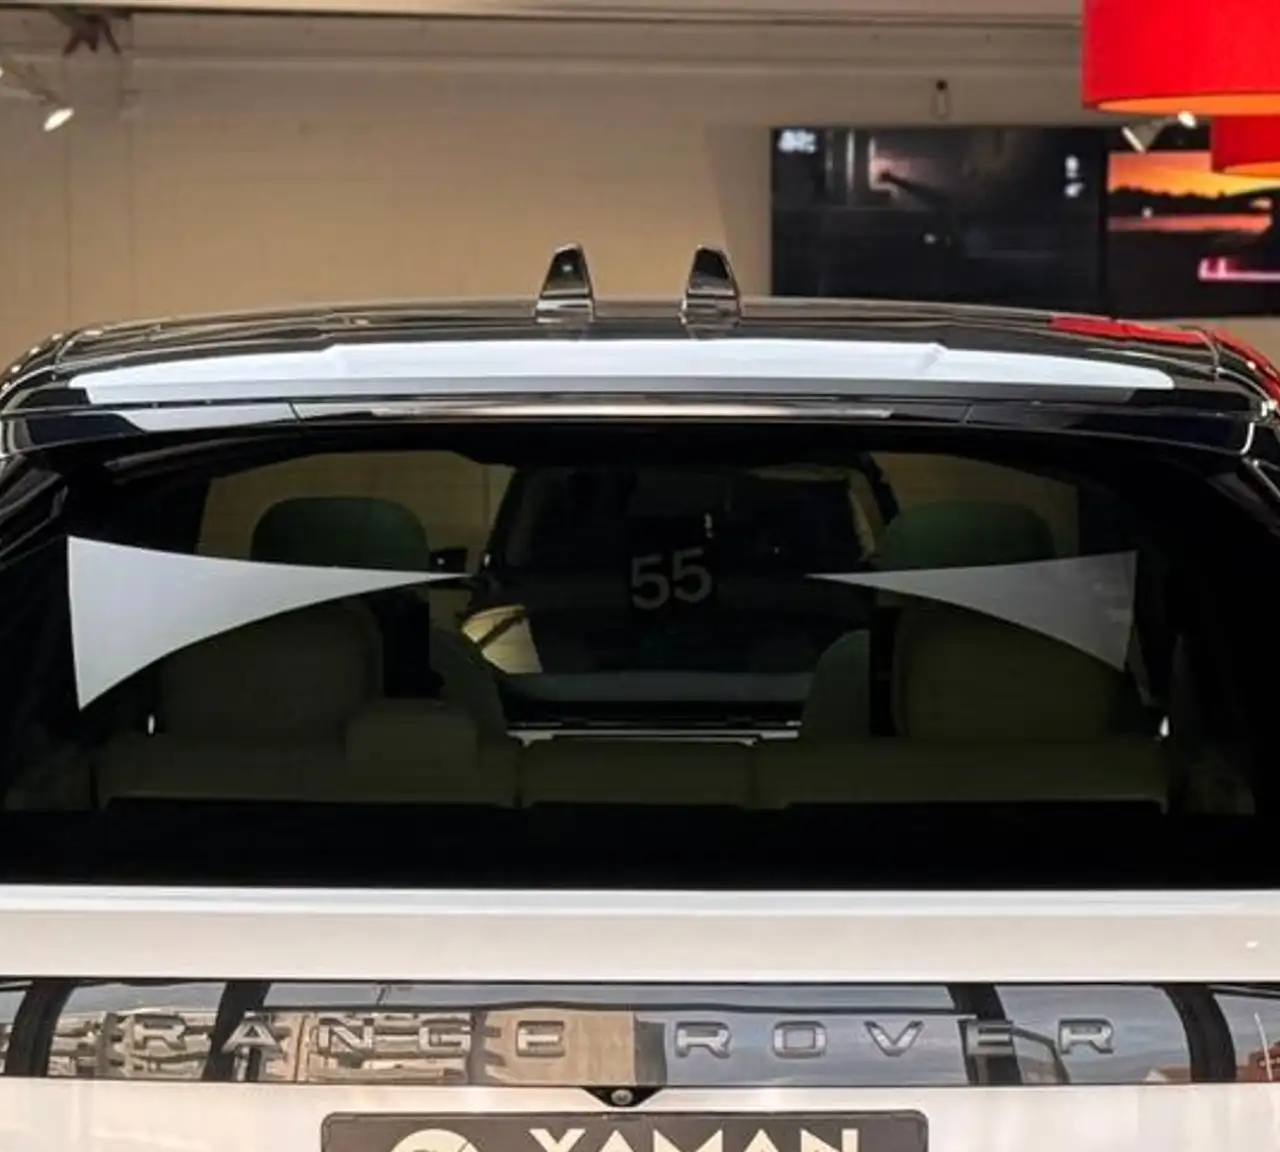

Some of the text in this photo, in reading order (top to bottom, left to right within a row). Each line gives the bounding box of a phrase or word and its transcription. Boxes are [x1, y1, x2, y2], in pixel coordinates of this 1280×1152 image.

[630, 546, 713, 610] 55
[132, 1012, 1116, 1060] RANGE ROVER
